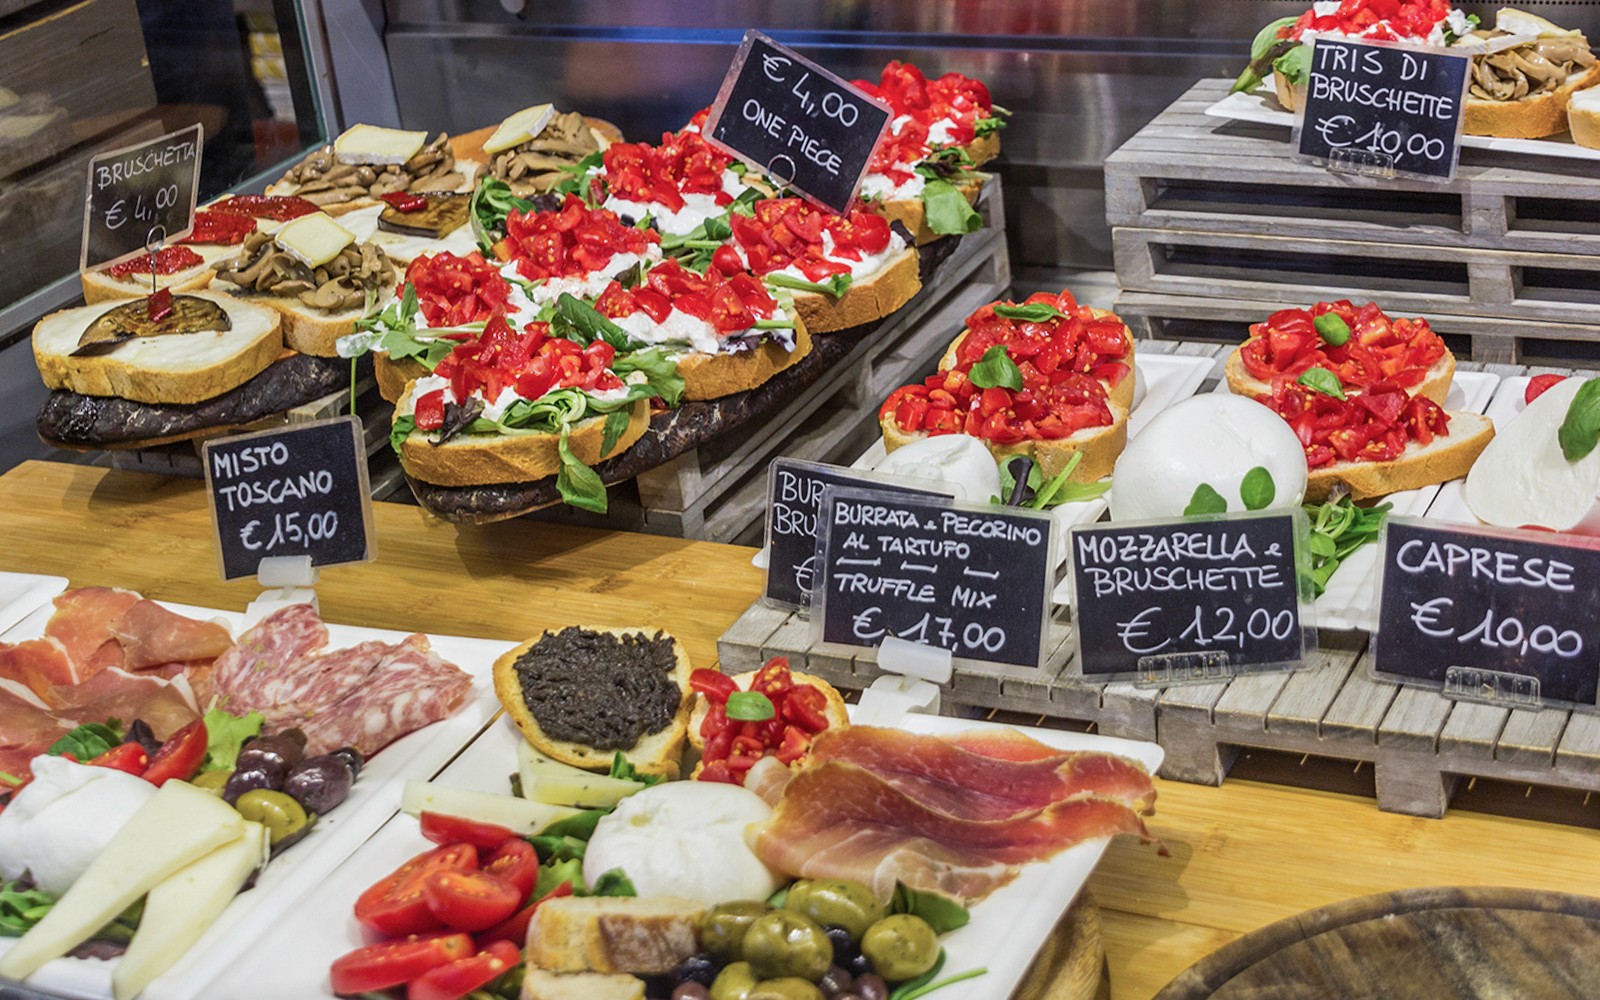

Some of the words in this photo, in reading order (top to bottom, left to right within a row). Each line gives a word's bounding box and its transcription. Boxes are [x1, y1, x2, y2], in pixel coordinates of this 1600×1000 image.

[1316, 44, 1383, 75] TRIS
[1400, 53, 1428, 81] DI
[762, 53, 792, 82] €
[792, 72, 859, 127] 4,00
[1310, 72, 1453, 120] BRUSCHETTE
[742, 99, 787, 138] ONE
[787, 125, 842, 175] PIECE
[97, 142, 196, 190] BRUSCHETTA
[105, 200, 127, 229] €
[135, 184, 178, 220] 4,00
[214, 442, 289, 479] MISTO
[219, 470, 333, 511] TOSCANO
[779, 471, 831, 507] BUR
[773, 503, 818, 538] BRU
[835, 502, 919, 529] BURRATA
[940, 512, 1042, 546] PECORINO
[843, 531, 870, 550] AL
[877, 535, 971, 559] TARTUFO
[1077, 532, 1256, 566] MOZZARELLA
[1084, 565, 1283, 598] BRUSCHETTE
[1396, 540, 1575, 591] CAPRESE
[833, 573, 935, 602] TRUFFLE
[951, 585, 997, 609] MIX
[898, 612, 1006, 652] 17,00
